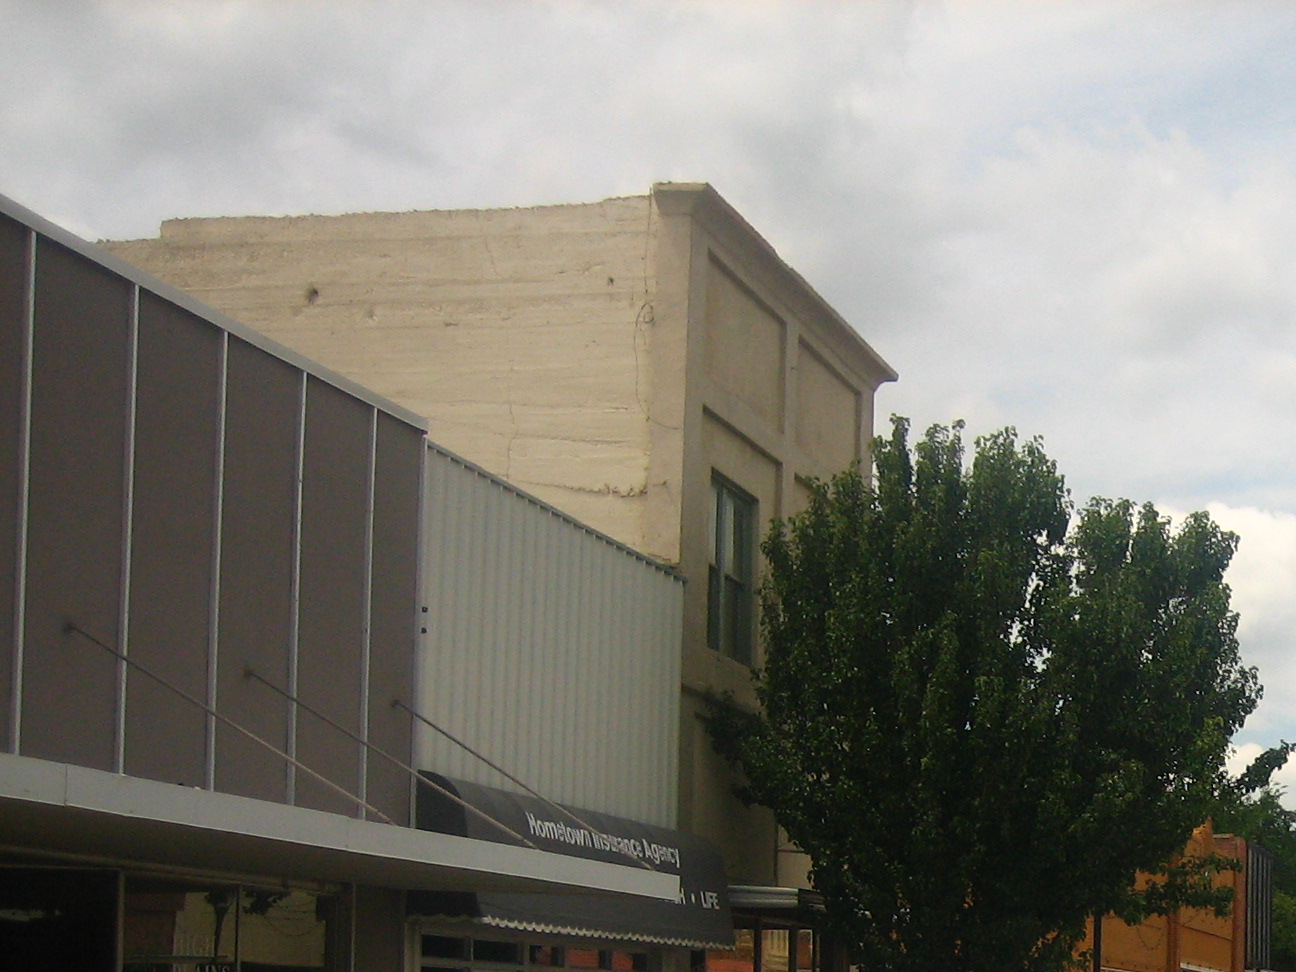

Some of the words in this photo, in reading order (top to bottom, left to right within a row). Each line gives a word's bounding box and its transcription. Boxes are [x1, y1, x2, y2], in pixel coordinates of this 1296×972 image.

[525, 812, 591, 848] Hometown
[642, 838, 680, 868] Agency
[701, 890, 721, 911] LIFE
